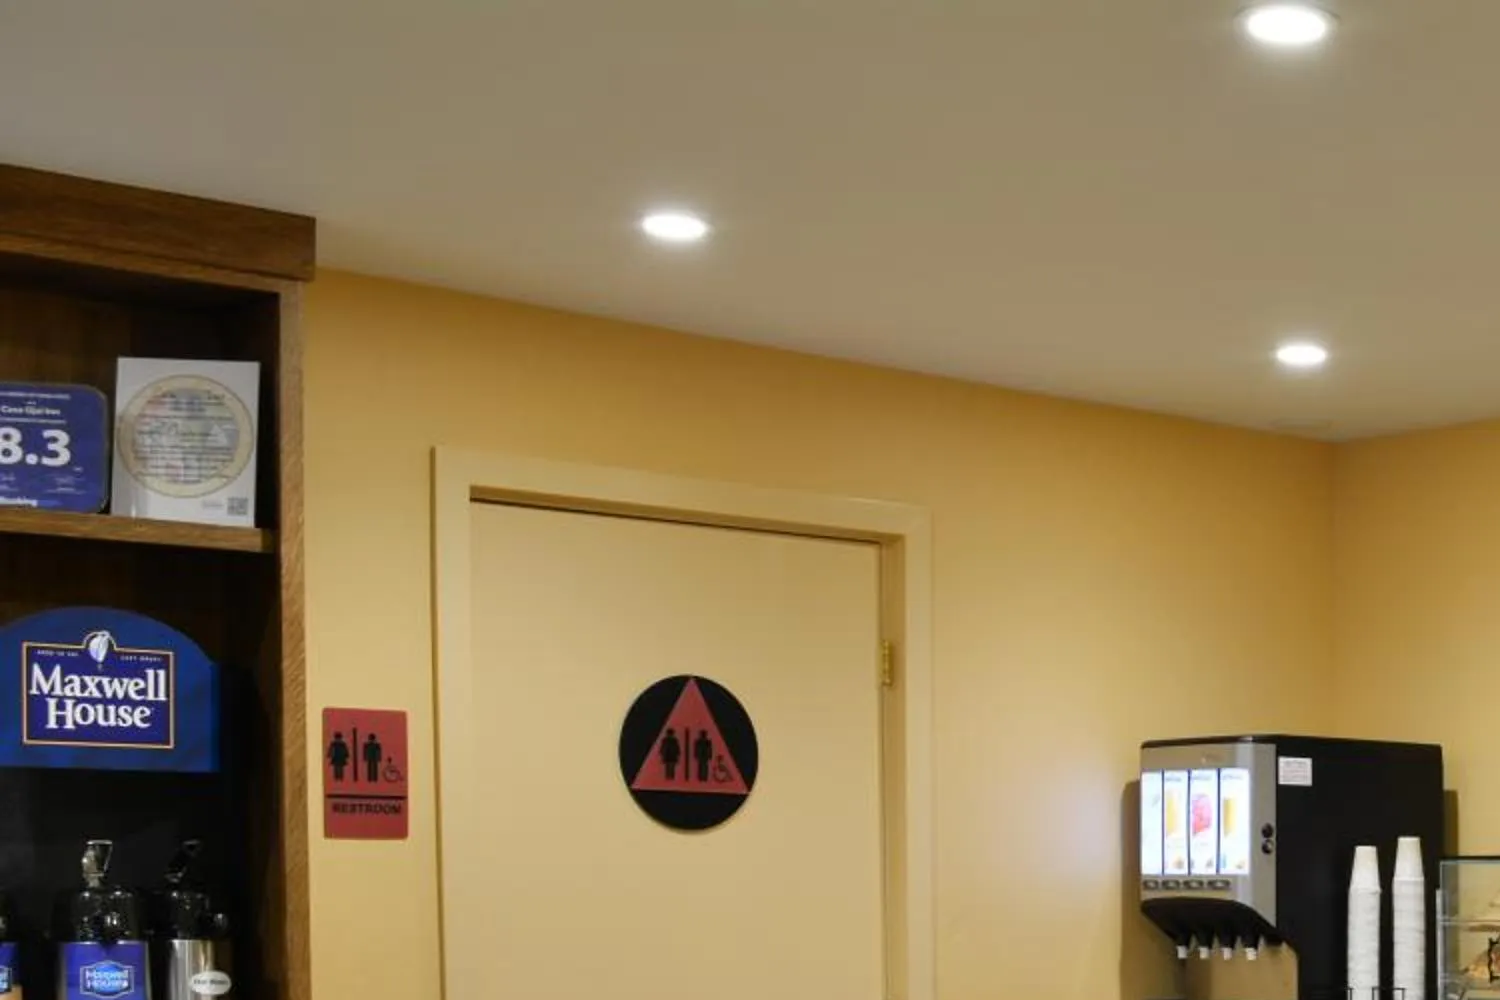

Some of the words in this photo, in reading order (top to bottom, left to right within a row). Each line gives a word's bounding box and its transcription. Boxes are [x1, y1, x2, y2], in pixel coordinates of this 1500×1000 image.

[0, 426, 71, 467] 8.3
[29, 662, 168, 701] Maxwell
[45, 697, 152, 730] House
[332, 803, 402, 816] RESTROOM
